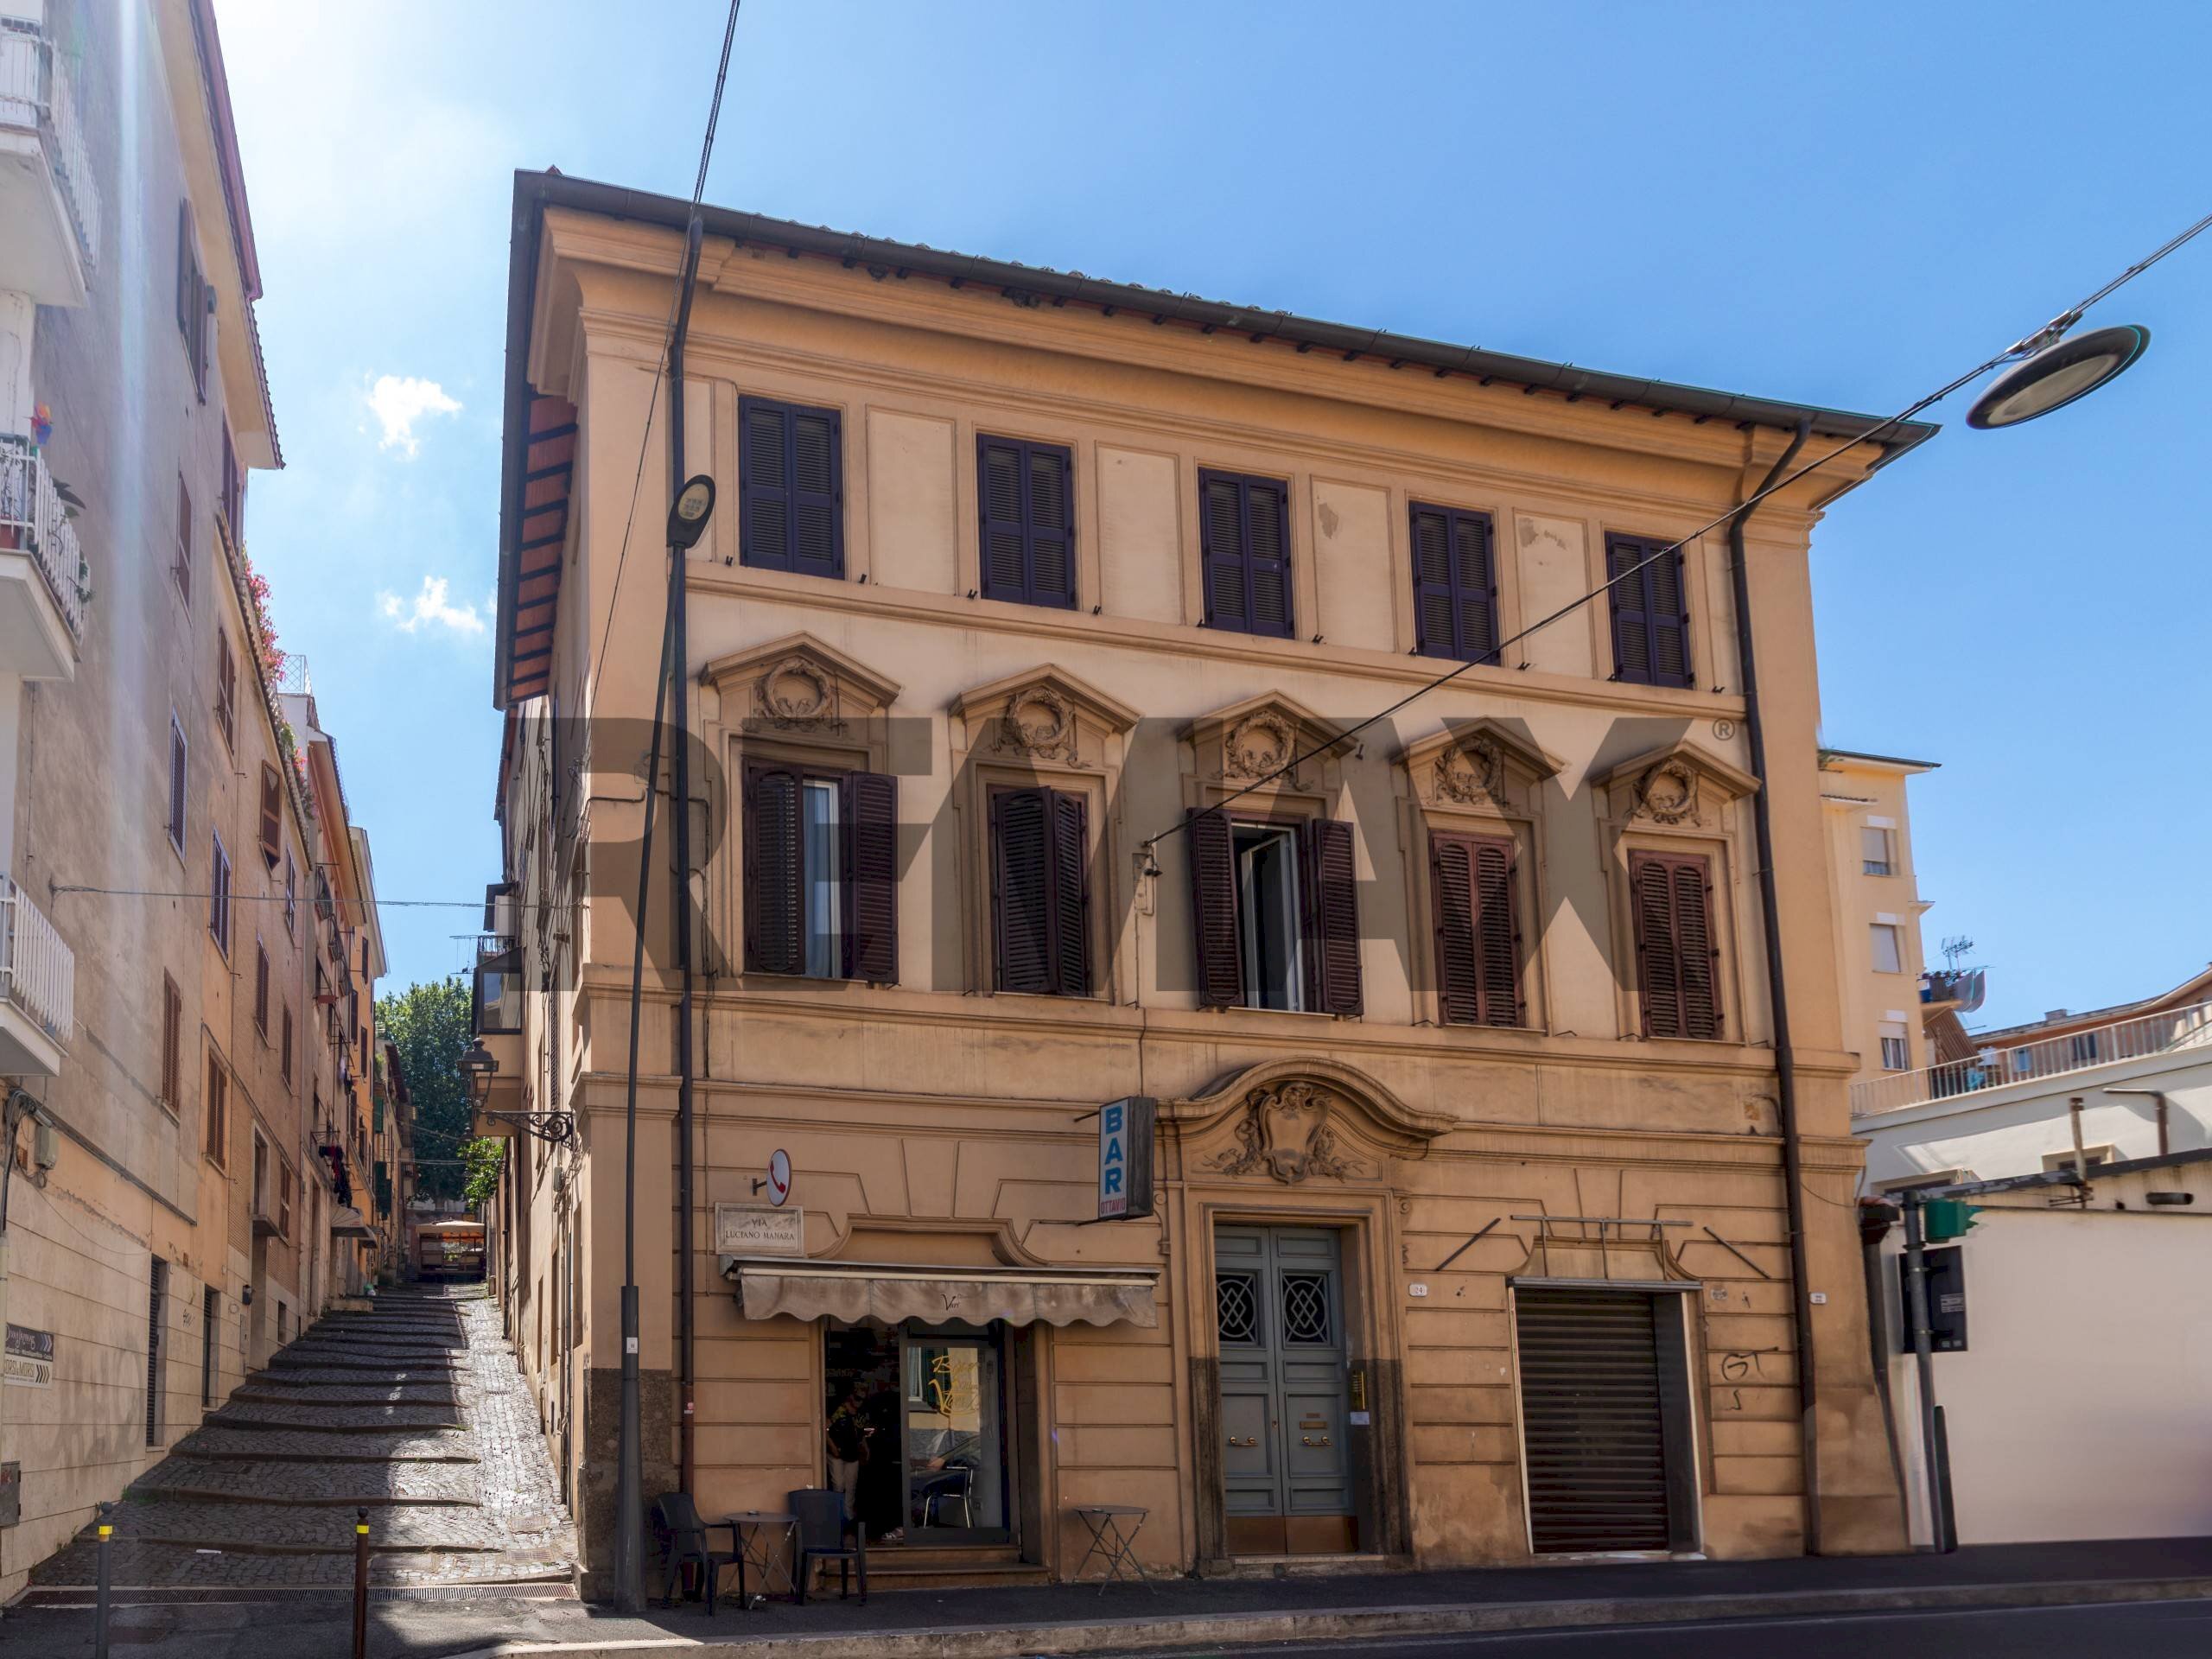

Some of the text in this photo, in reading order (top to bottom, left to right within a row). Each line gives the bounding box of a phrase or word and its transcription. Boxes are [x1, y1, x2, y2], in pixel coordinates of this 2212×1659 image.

[1104, 1106, 1123, 1195] BAR
[752, 1217, 768, 1228] VIA
[726, 1230, 795, 1241] LUCIANO MANARA
